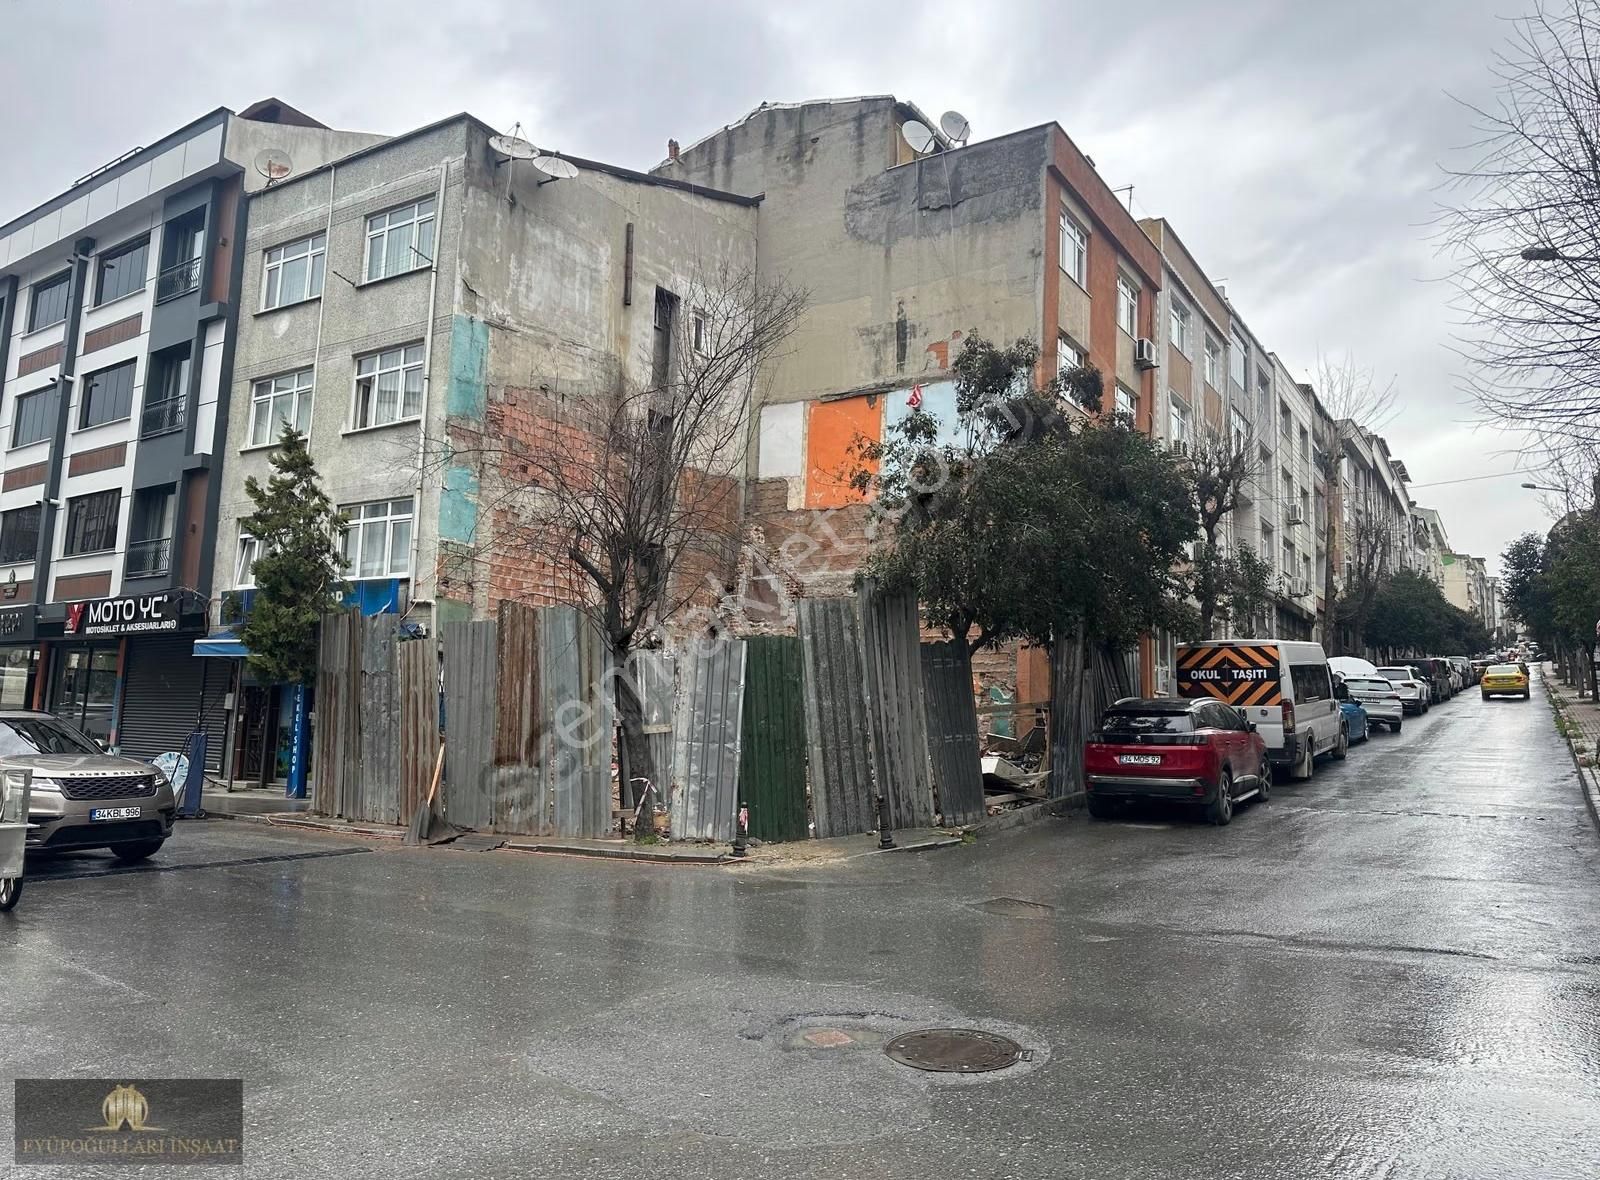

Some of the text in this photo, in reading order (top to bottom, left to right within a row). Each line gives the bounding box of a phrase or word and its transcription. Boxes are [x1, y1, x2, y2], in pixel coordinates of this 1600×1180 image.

[88, 599, 135, 623] MOTO
[85, 621, 171, 634] MOTOSİKLET & AKSESUARLARI
[1190, 669, 1267, 681] OKUL TAŞITI
